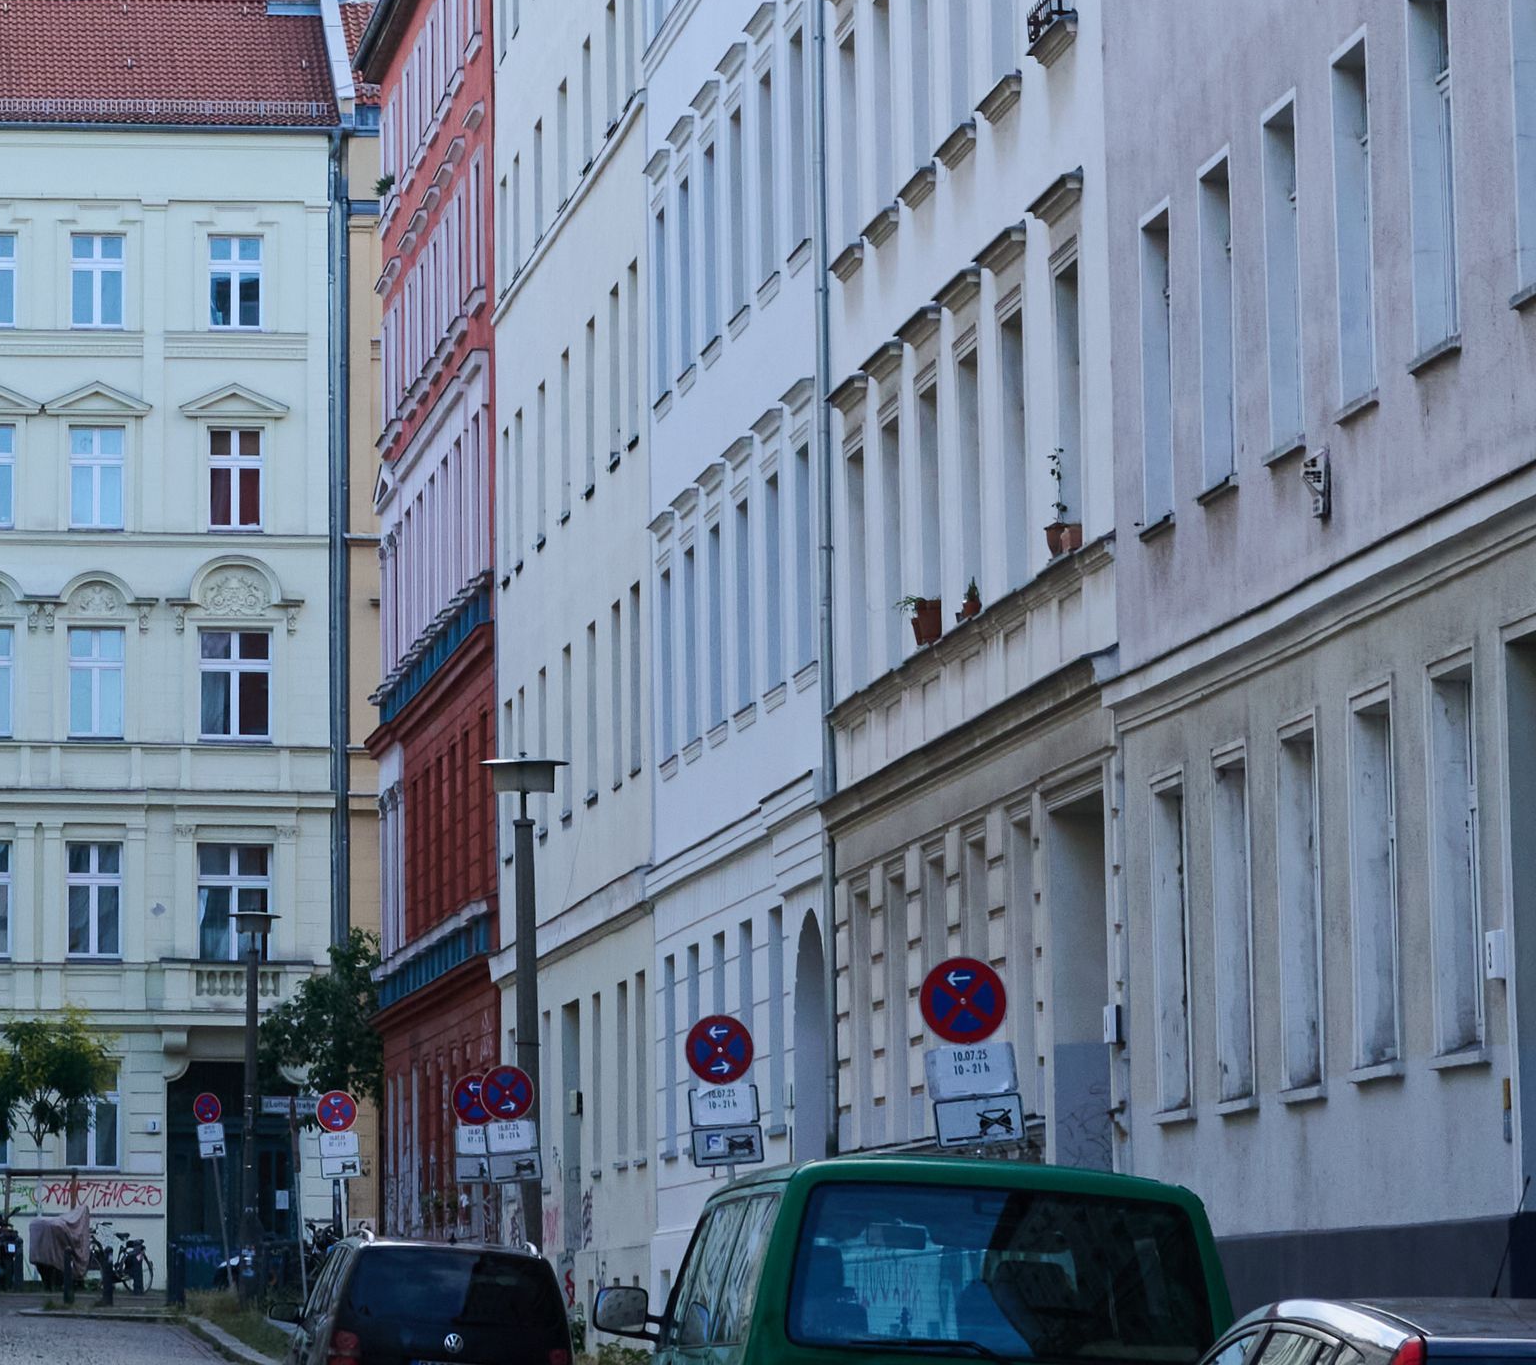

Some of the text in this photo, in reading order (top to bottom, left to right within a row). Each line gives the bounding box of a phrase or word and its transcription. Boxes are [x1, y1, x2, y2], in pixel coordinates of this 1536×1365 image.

[953, 1049, 988, 1061] 10.07.25
[954, 1065, 964, 1075] 10
[972, 1063, 982, 1074] 21
[984, 1062, 990, 1073] h
[708, 1089, 735, 1098] 10.07.25
[708, 1100, 717, 1110] 10
